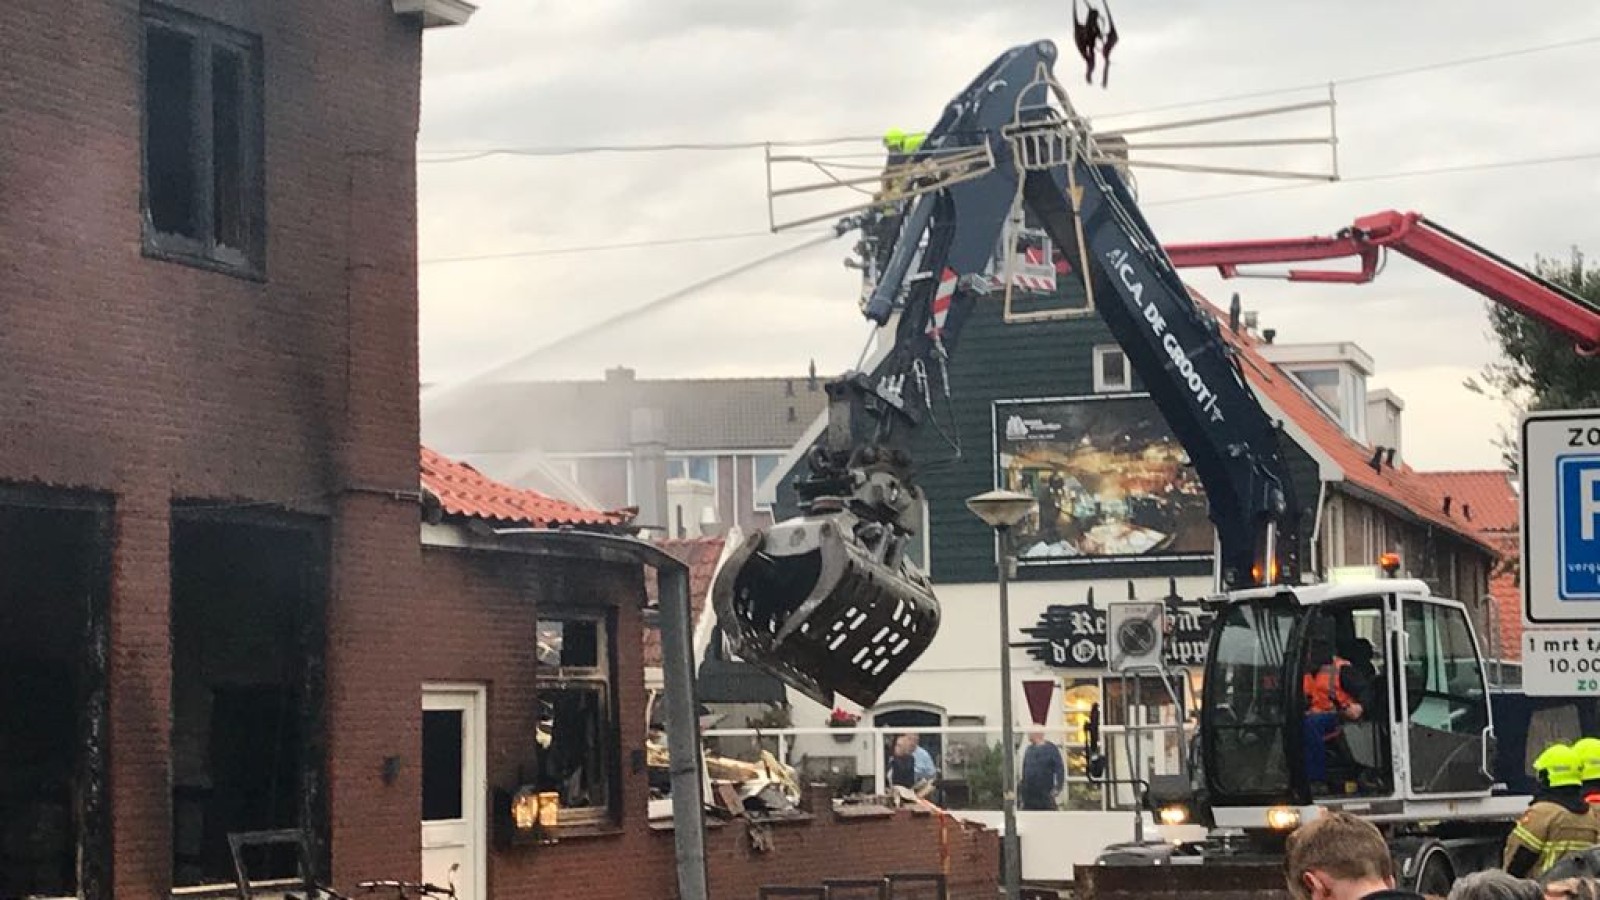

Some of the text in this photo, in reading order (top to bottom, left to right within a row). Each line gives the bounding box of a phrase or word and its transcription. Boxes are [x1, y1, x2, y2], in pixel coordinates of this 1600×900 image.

[1143, 302, 1167, 337] DE
[1163, 333, 1212, 403] GROOT
[1544, 637, 1579, 652] mrt
